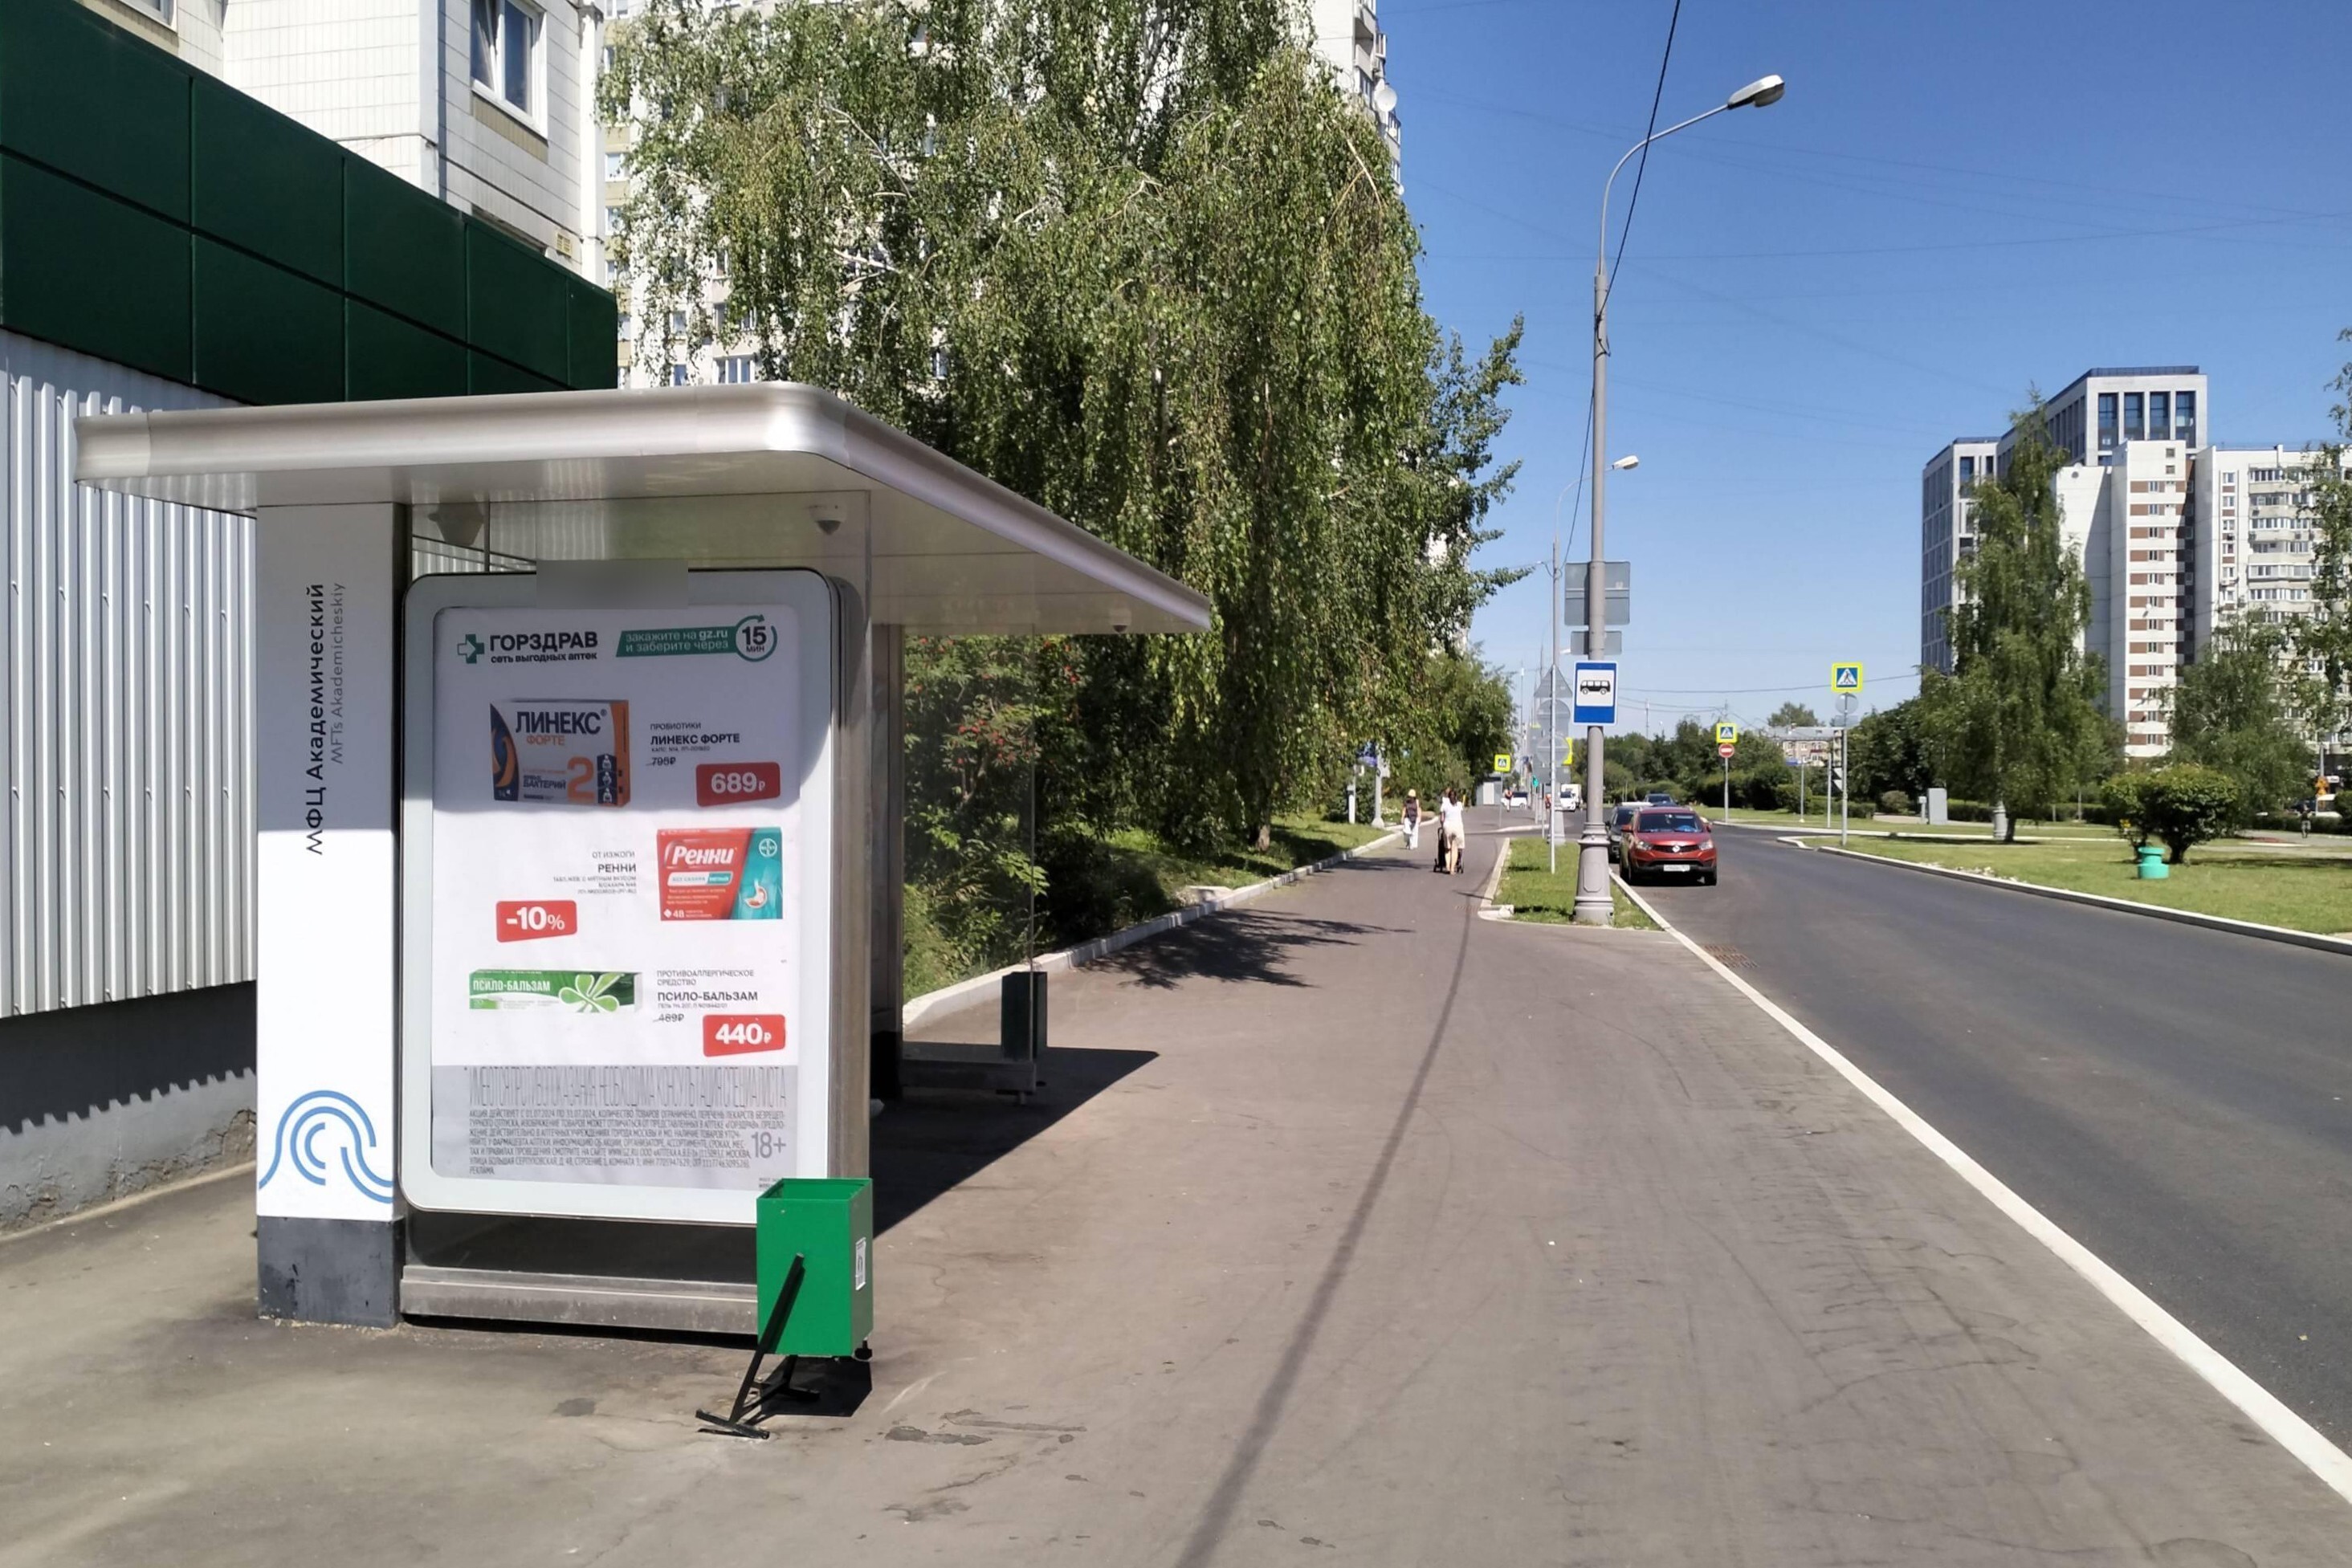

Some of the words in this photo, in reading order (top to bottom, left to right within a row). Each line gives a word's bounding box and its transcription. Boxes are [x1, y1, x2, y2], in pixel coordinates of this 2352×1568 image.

[490, 631, 598, 653] ГОРЗДРАВ
[626, 632, 681, 642] закажите
[683, 632, 697, 640] на
[699, 629, 728, 641] gz.ru
[742, 625, 767, 646] 15
[330, 582, 346, 717] Akademicheskiy
[636, 641, 691, 653] заберите
[694, 640, 729, 651] через
[491, 655, 513, 663] сеть
[516, 654, 566, 662] выгодных
[568, 652, 597, 661] аптек
[306, 584, 326, 780] Академический
[516, 711, 601, 735] ЛИНЕКС
[650, 723, 701, 731] ПРОБИОТИКИ
[331, 723, 344, 764] MFTs
[526, 735, 565, 746] ФОРТЕ
[650, 735, 698, 745] ЛИНЕКС
[700, 733, 740, 744] ФОРТЕ
[524, 779, 566, 790] БАКТЕРИЙ
[567, 755, 595, 802] 2
[306, 787, 326, 855] МФЦ
[604, 851, 635, 859] ИЗЖОГИ
[672, 845, 735, 865] Ренни
[597, 863, 636, 873] РЕННИ
[506, 906, 565, 931] -10%
[473, 980, 551, 992] ПСИЛО-БАЛЬЗАМ
[658, 992, 758, 1001] ПСИЛО-БАЛЬЗАМ
[752, 1131, 787, 1159] 18+
